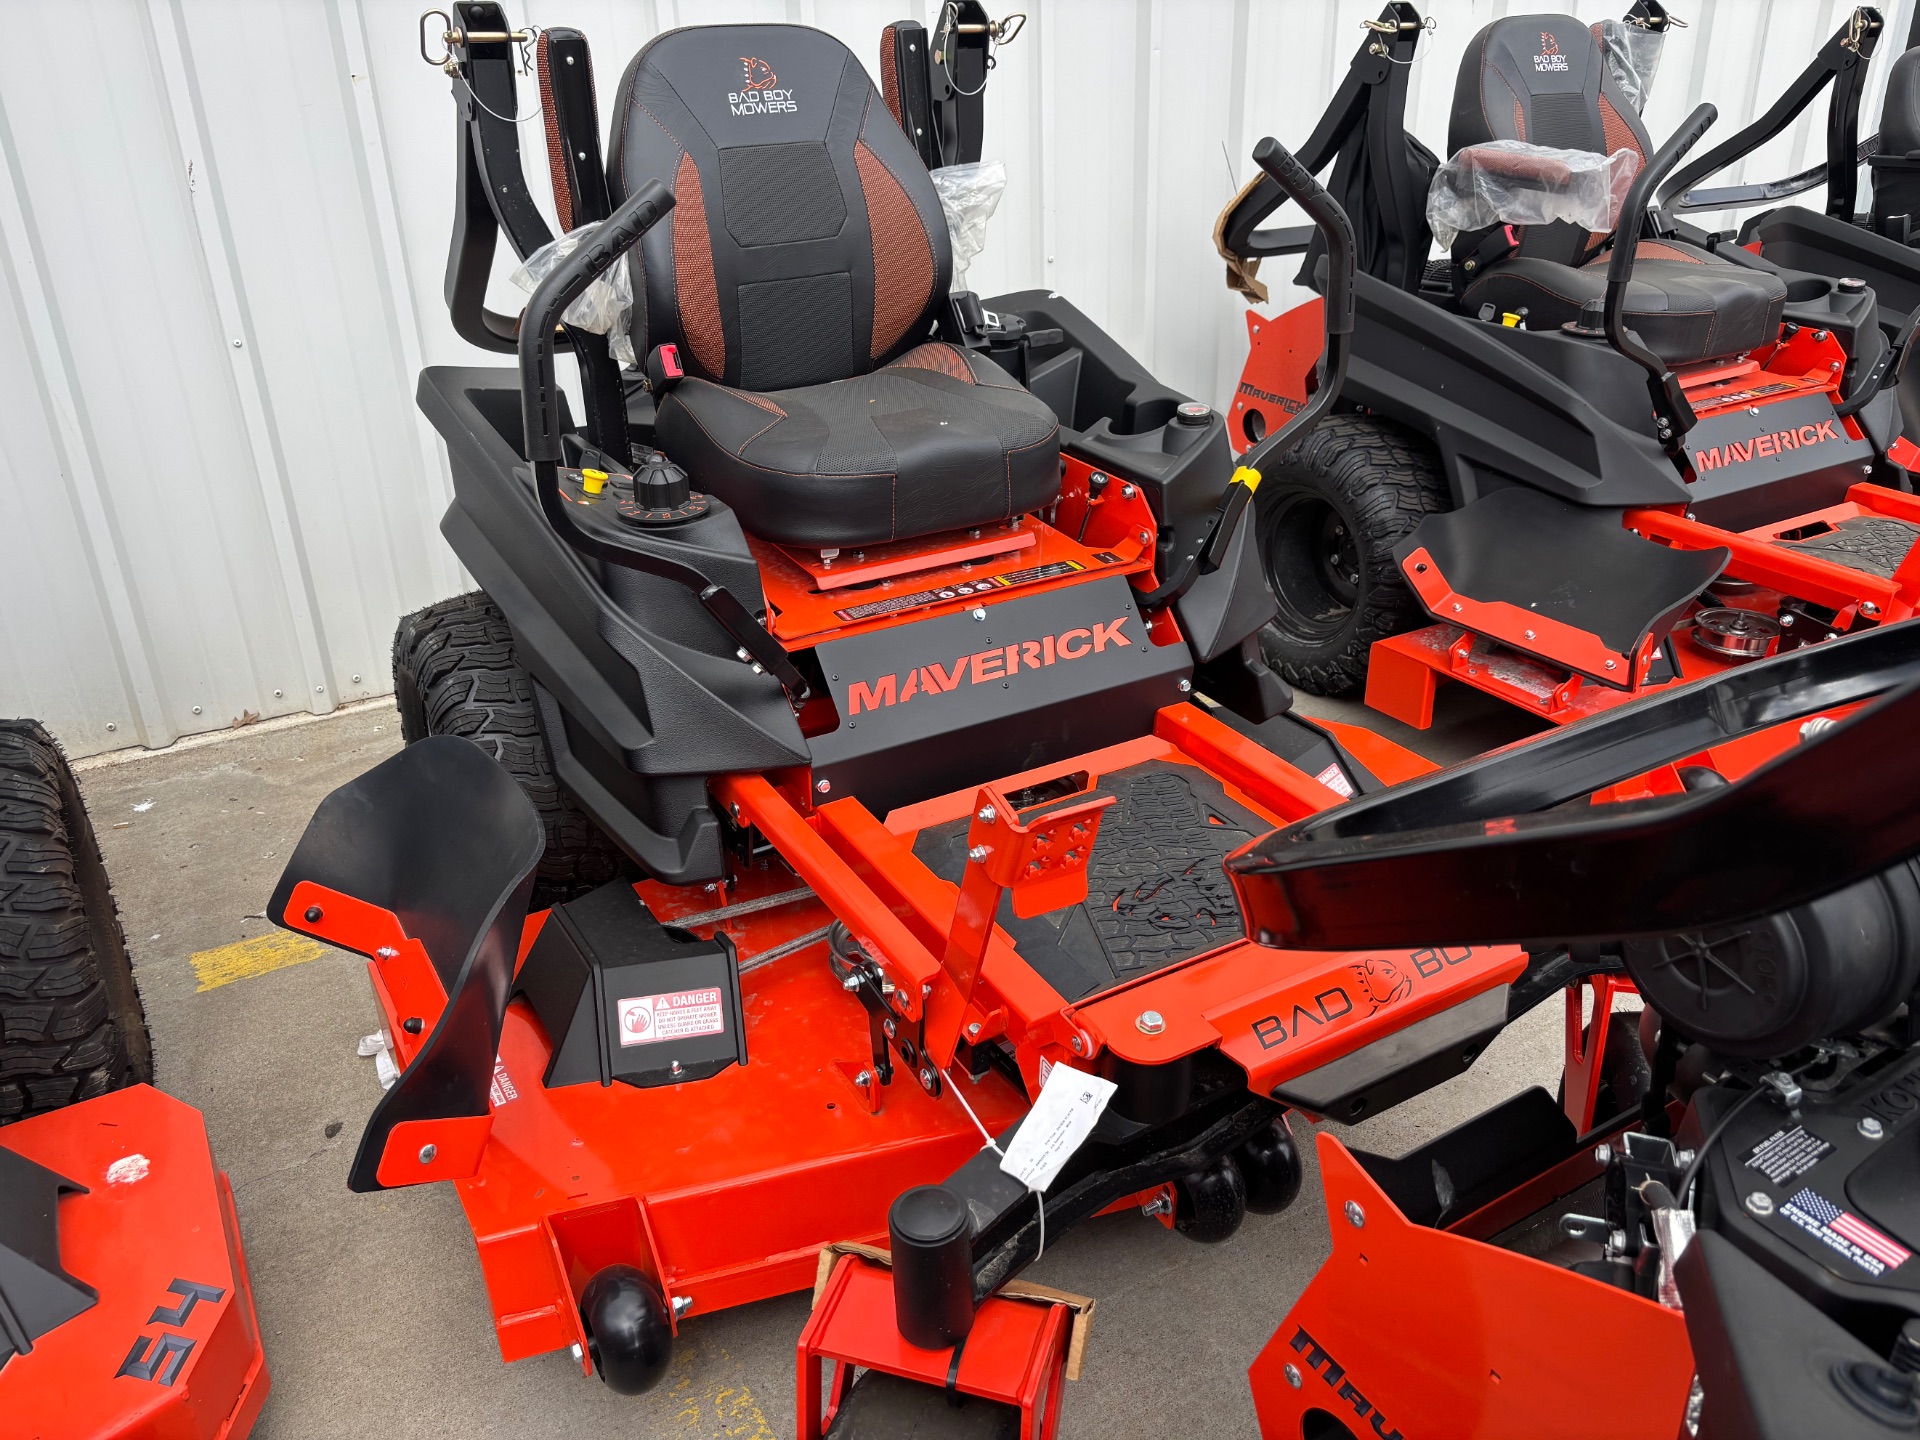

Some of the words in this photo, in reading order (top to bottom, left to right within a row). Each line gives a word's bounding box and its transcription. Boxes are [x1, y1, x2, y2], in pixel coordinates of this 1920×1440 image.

[1533, 55, 1549, 63] BAD
[1535, 63, 1568, 72] MOWERS
[728, 91, 760, 103] BAD
[763, 89, 793, 101] BOY
[731, 101, 797, 116] MOWERS
[1277, 151, 1324, 200] BOY
[581, 201, 657, 275] BAD
[1239, 382, 1307, 412] MAVERICK
[1695, 419, 1840, 474] MAVERICK
[848, 616, 1133, 716] MAVERICK
[672, 992, 717, 1007] DANGER
[1251, 987, 1353, 1050] BAD
[1409, 945, 1492, 979] BO
[497, 1072, 518, 1101] DANGER
[1758, 1139, 1772, 1148] FUEL
[1769, 1130, 1785, 1141] FILTER
[1783, 1202, 1821, 1227] ENGINE
[1819, 1226, 1850, 1246] MADE
[1849, 1245, 1864, 1255] IN
[1862, 1254, 1886, 1269] USA
[1804, 1224, 1823, 1237] AND
[1821, 1236, 1853, 1257] GLOBAL
[114, 1278, 226, 1387] 54
